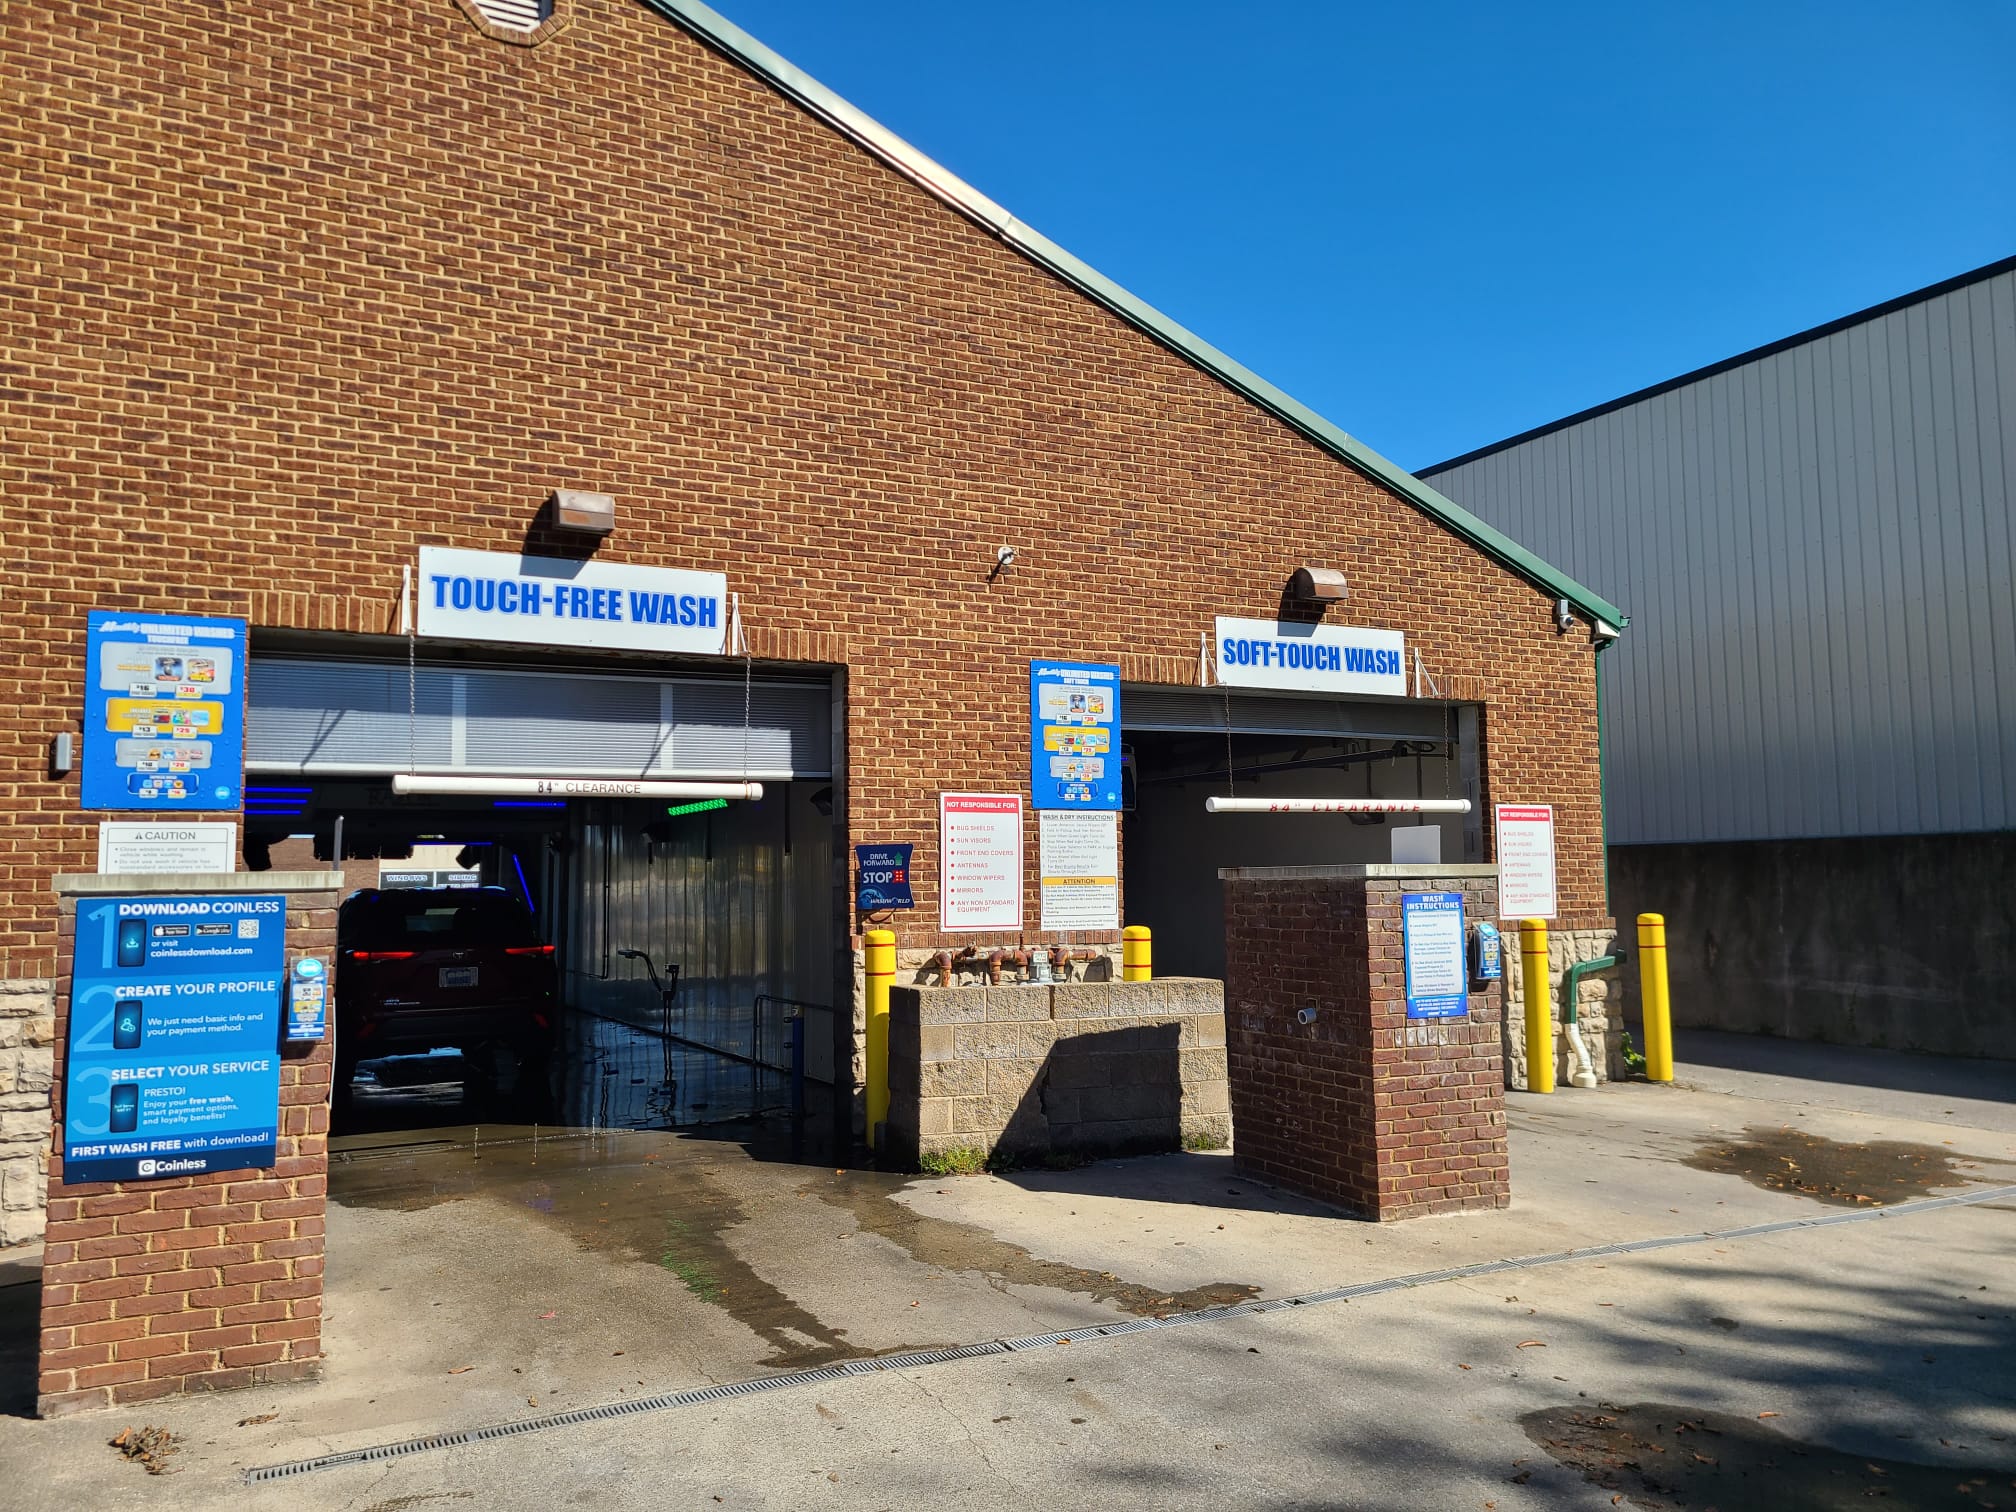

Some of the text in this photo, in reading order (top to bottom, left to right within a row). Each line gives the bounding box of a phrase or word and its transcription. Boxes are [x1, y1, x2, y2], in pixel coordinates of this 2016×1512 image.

[430, 574, 719, 629] TOUCH-FREE WASH
[1223, 638, 1400, 675] SOFT-TOUCH WASH
[537, 781, 641, 794] 84" CLEARANCE
[1312, 802, 1420, 812] CLEARANCE
[144, 832, 196, 840] CAUTION
[386, 874, 428, 882] WINDOWS
[863, 872, 892, 884] STOP
[119, 902, 280, 916] DOWNLOAD COINLESS
[1406, 902, 1460, 910] INSTRUCTIONS
[88, 904, 116, 969] 1
[150, 946, 252, 958] coinlessdownload.com
[115, 981, 276, 998] CREATE YOUR PROFILE
[74, 985, 121, 1053] 2
[147, 1012, 264, 1027] We just need basic info and
[146, 1024, 243, 1037] your payment method.
[112, 1060, 270, 1080] SELECT YOUR SERVICE
[144, 1087, 186, 1097] PRESTO!
[72, 1067, 113, 1135] 3
[144, 1100, 167, 1108] Enjoy
[168, 1099, 188, 1108] your
[190, 1096, 207, 1105] free
[143, 1108, 166, 1116] smart
[168, 1106, 204, 1116] payment
[143, 1112, 225, 1125] and loyalty benefits!
[72, 1132, 269, 1158] FIRST WASH FREE with download!
[156, 1159, 206, 1172] Coinless
